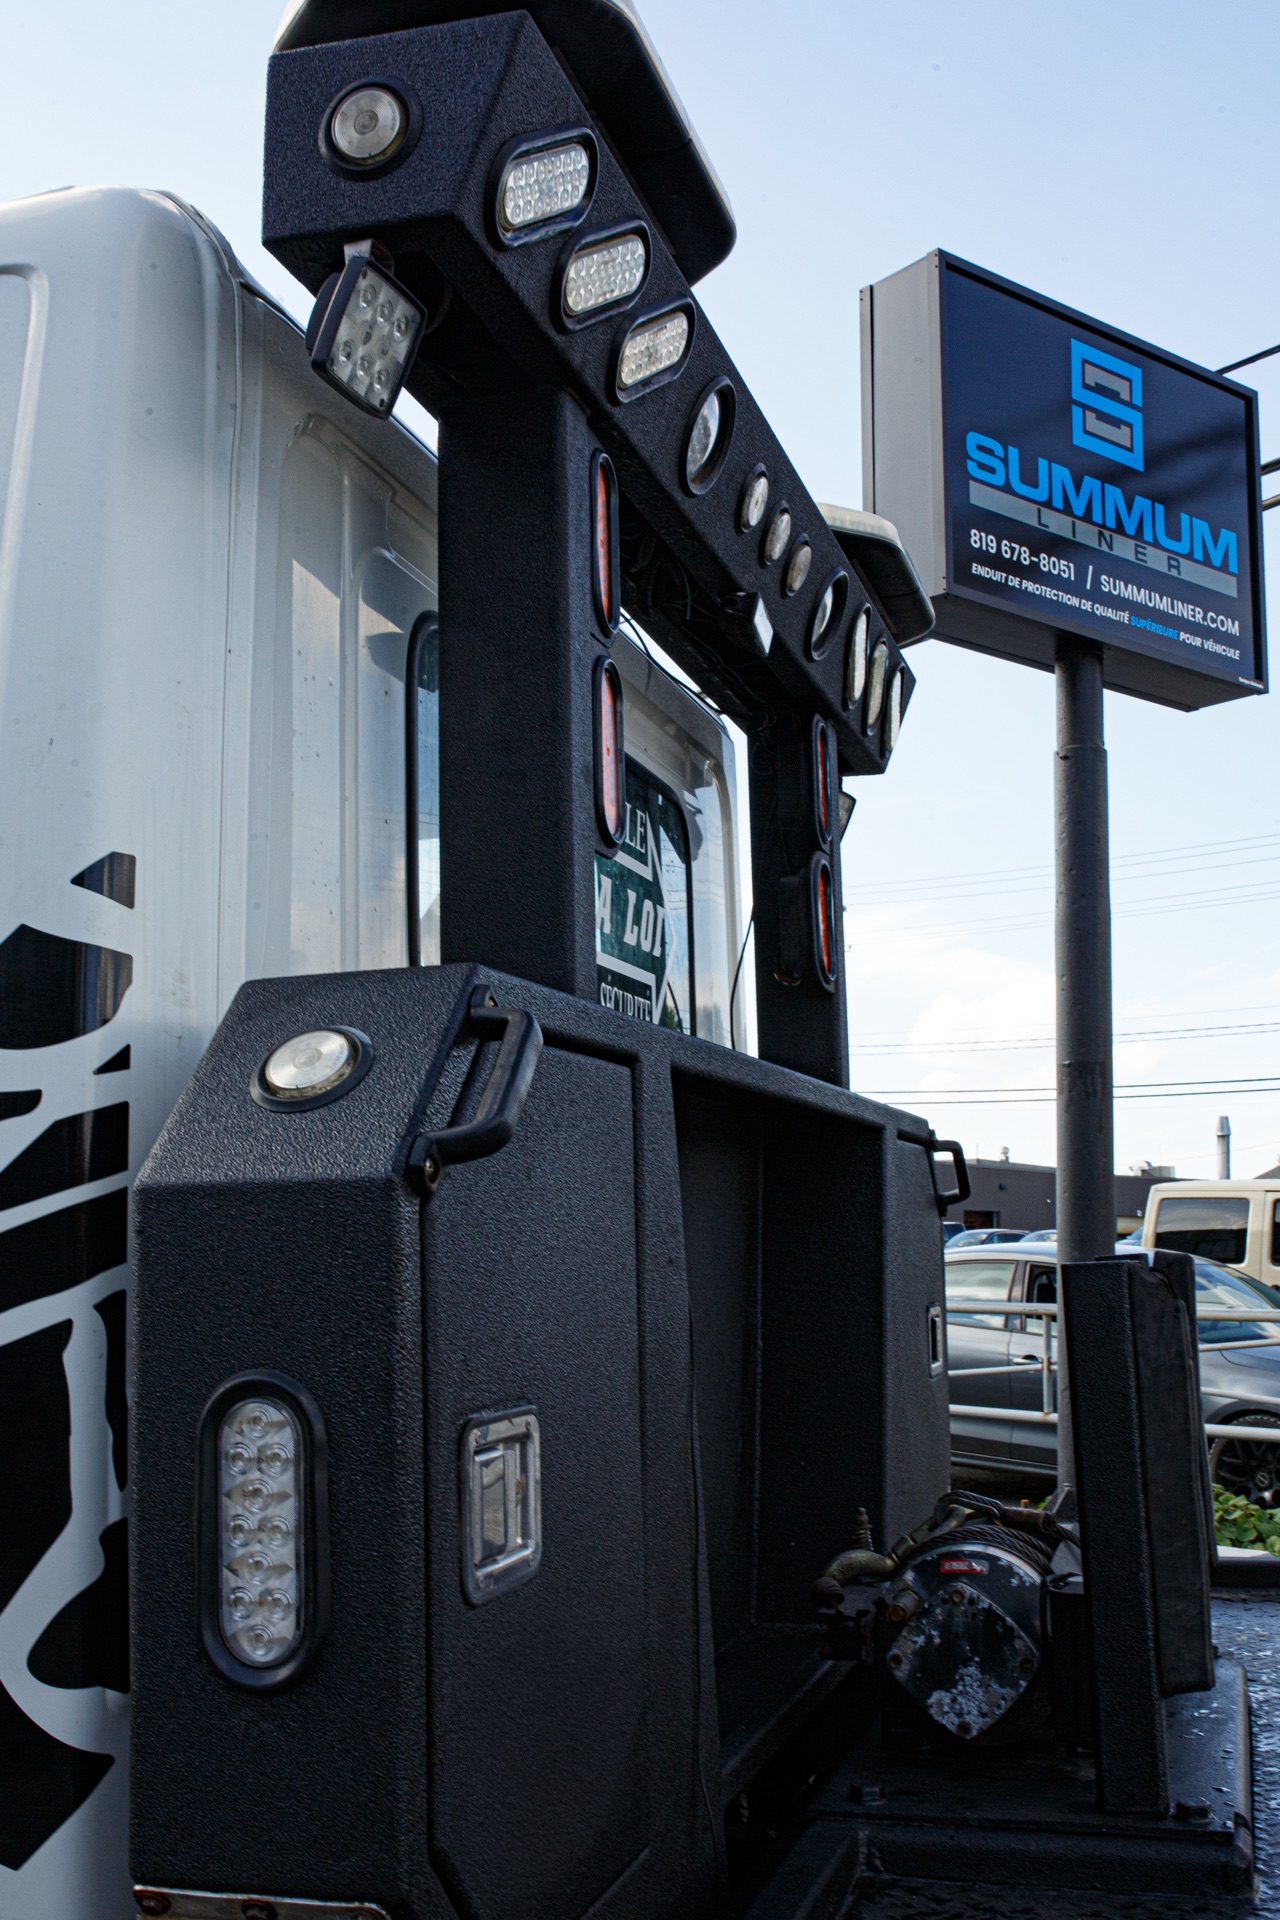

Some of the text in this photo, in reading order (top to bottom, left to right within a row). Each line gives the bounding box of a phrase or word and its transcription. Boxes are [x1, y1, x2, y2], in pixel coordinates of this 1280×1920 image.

[965, 431, 1239, 574] SUMMUM
[1037, 507, 1181, 576] LINER
[970, 528, 997, 554] 819
[1001, 539, 1075, 581] 678-8051
[1100, 575, 1240, 637] SUMMUMLINER.COM
[971, 562, 1241, 660] ENDUIT DE PROTECTION DE QUALITÉ SUPÉRIEURE POUR VÉHICULE
